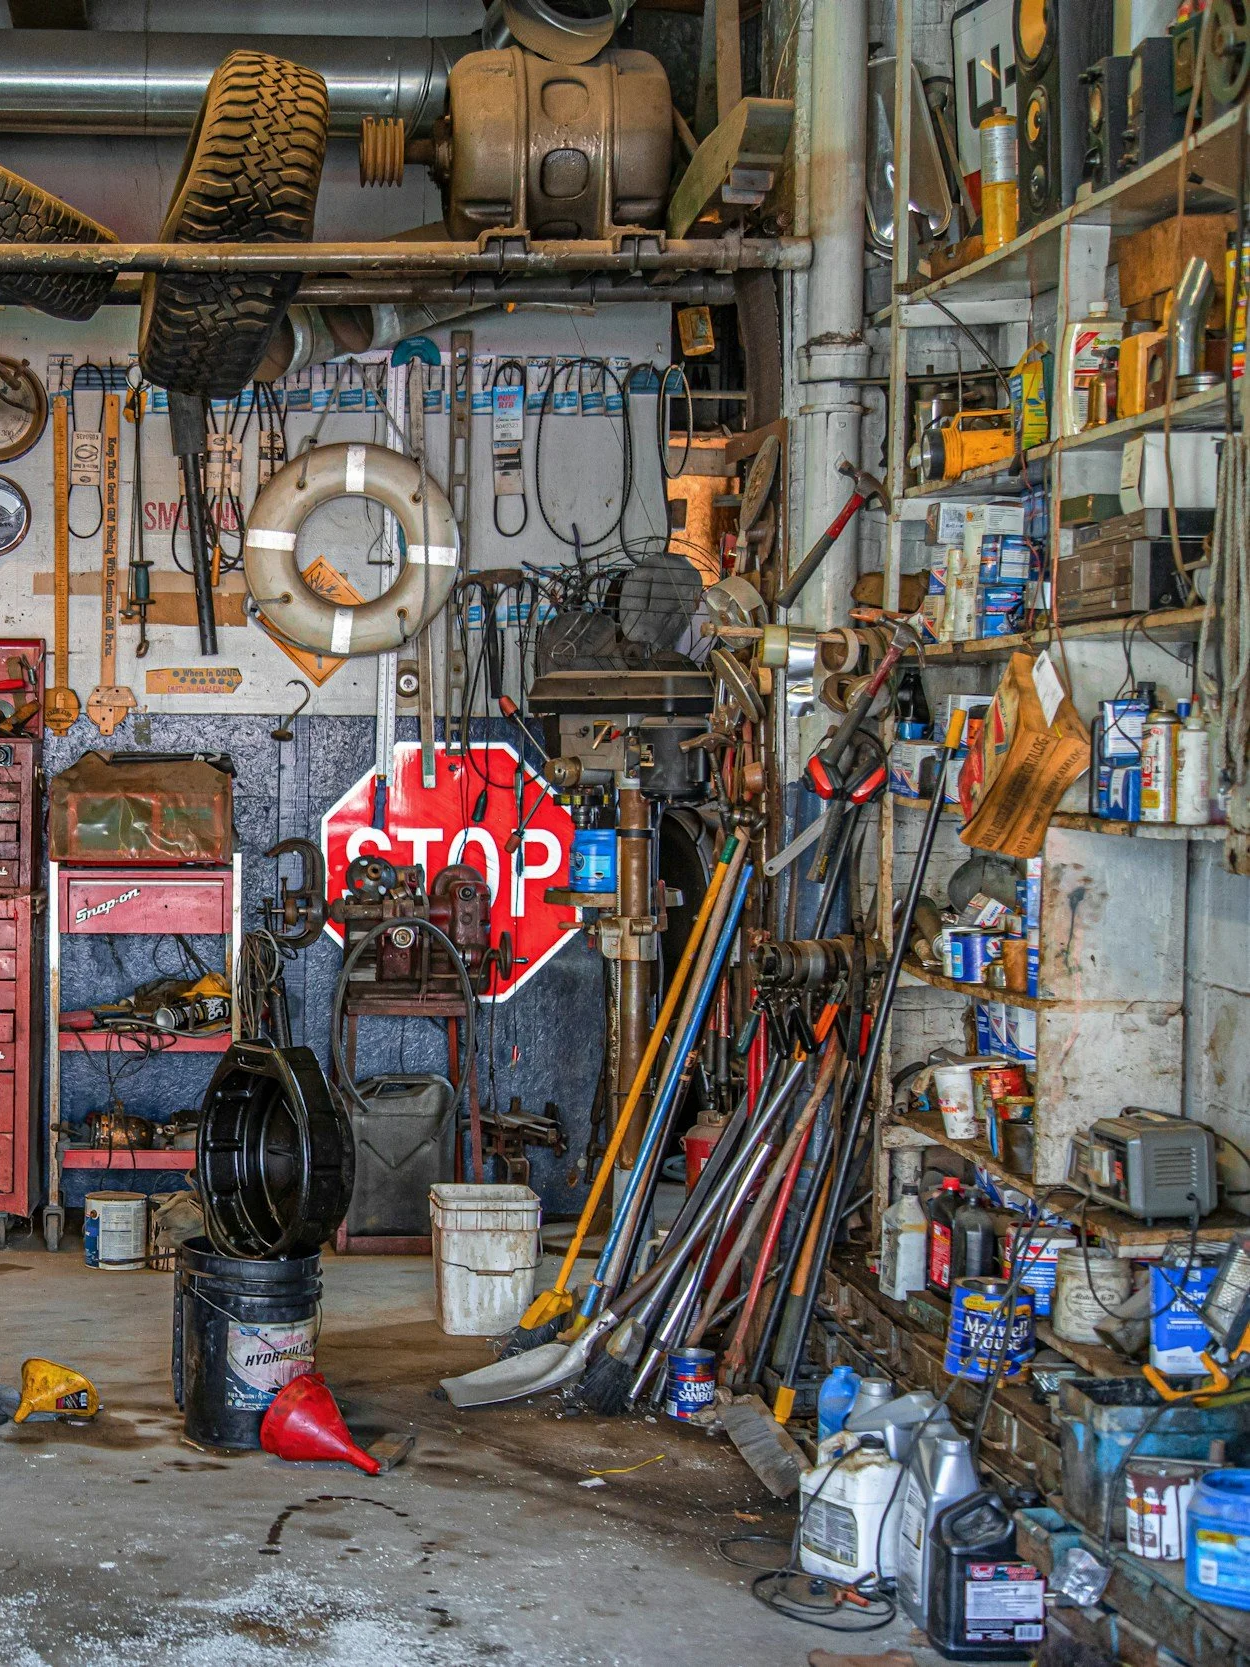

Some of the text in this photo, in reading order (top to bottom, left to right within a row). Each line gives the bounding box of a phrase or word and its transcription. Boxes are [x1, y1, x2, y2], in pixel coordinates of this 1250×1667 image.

[105, 437, 117, 457] Keep
[107, 459, 117, 480] That
[107, 482, 116, 505] Great
[106, 506, 116, 526] GM
[104, 527, 116, 554] Feeling
[106, 556, 115, 578] With
[105, 579, 115, 614] Genuine
[183, 669, 204, 677] When
[206, 668, 213, 677] in
[75, 887, 141, 924] Snap-on
[678, 1390, 715, 1402] SANBO
